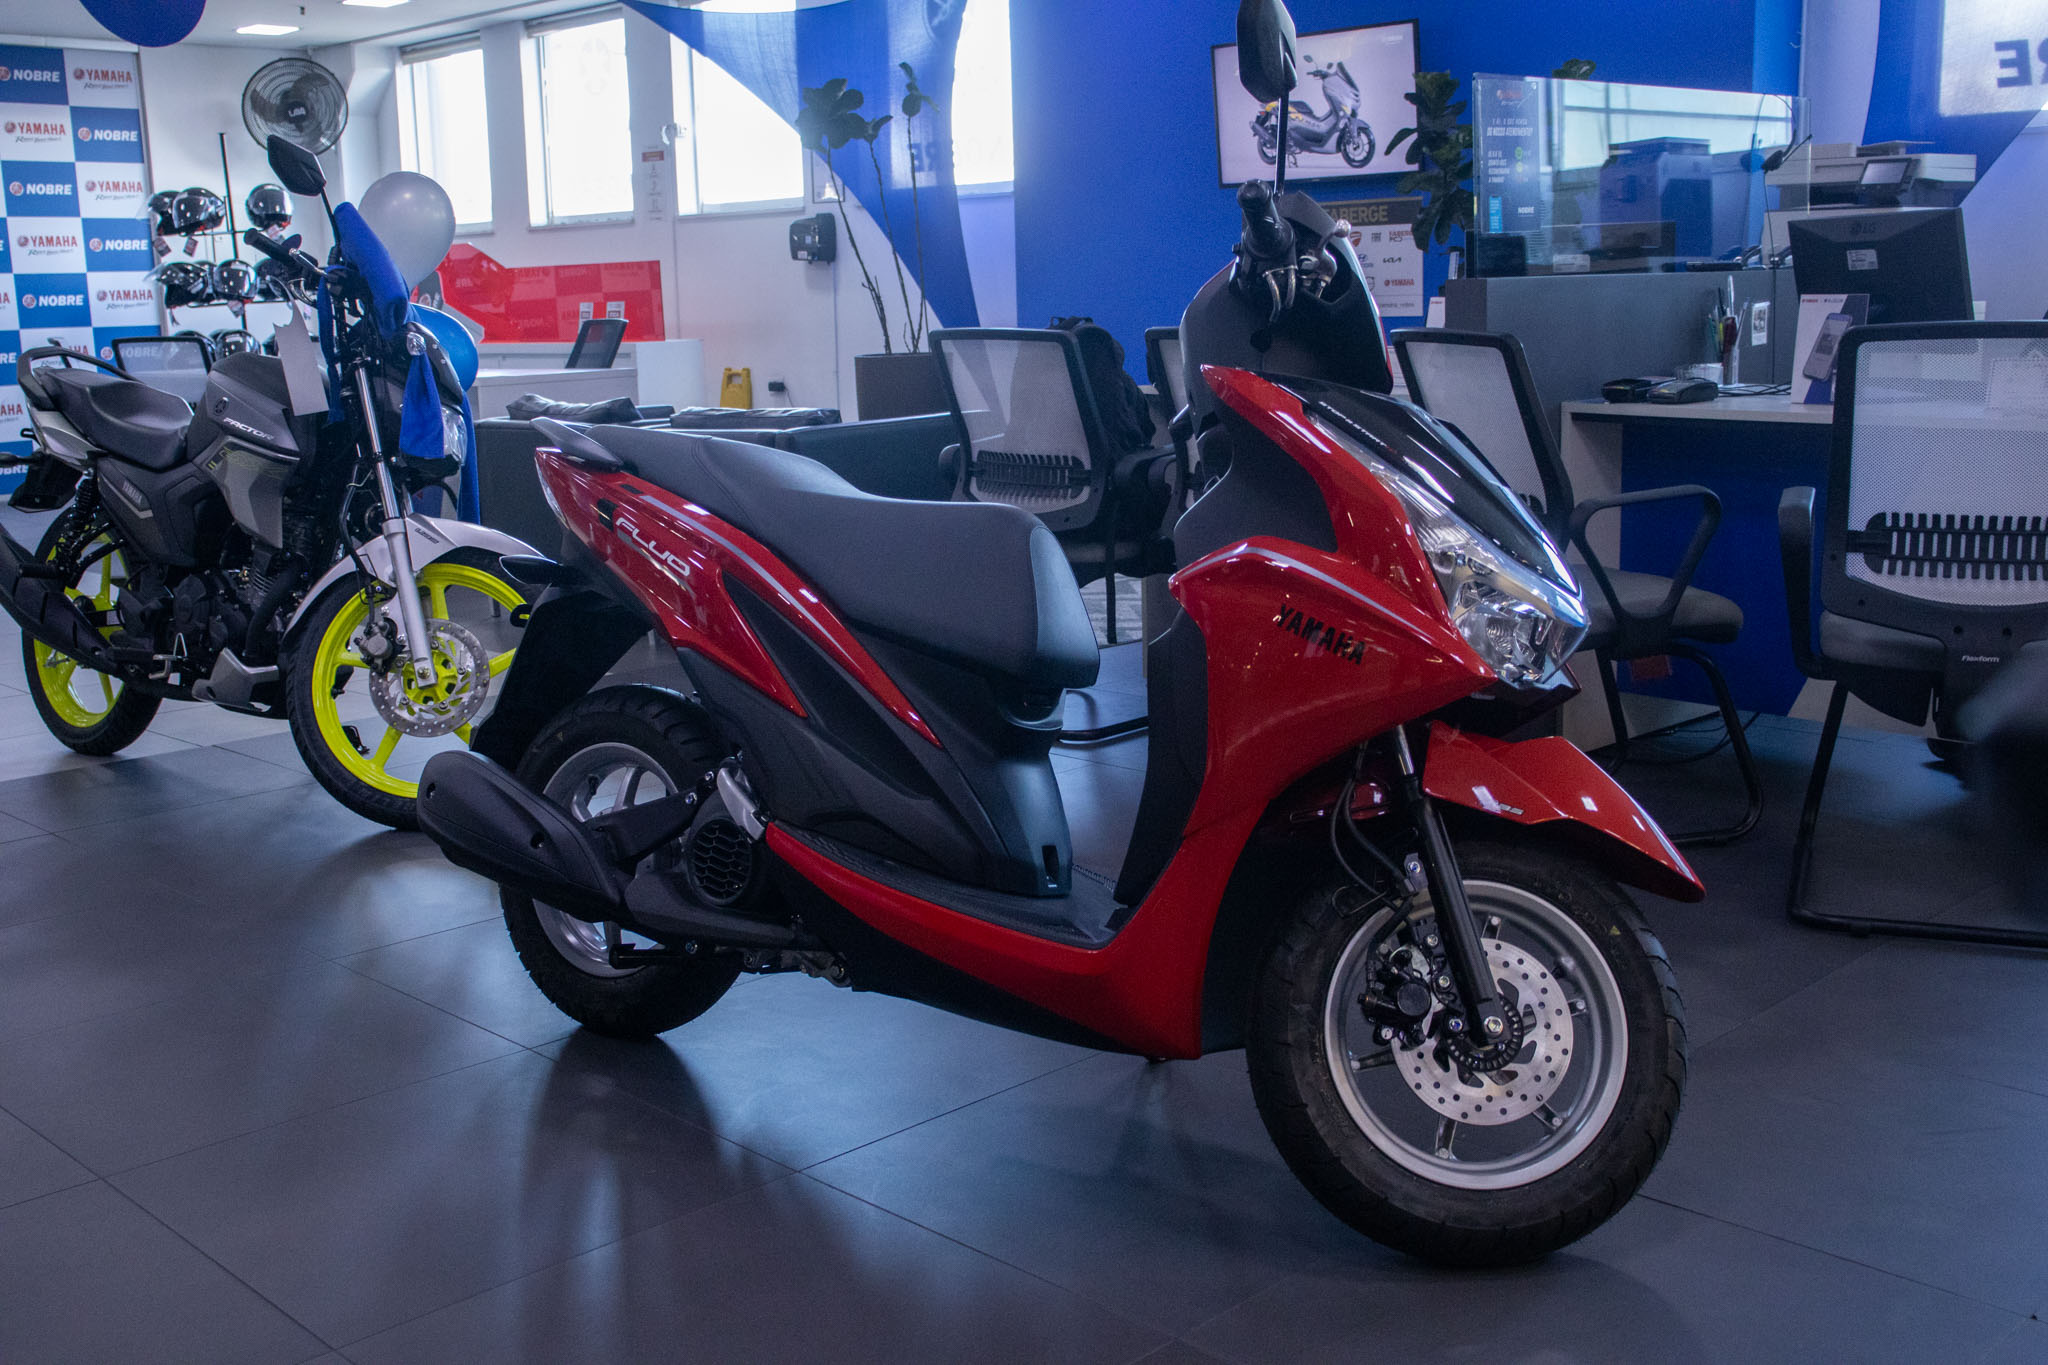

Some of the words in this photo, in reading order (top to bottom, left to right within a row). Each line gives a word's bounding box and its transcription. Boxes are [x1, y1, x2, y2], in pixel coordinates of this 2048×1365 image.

[13, 68, 61, 83] NOBRE
[87, 69, 133, 83] YAMAHA
[18, 122, 66, 136] YAMAHA
[94, 129, 138, 142] NOBRE
[26, 183, 72, 195] NOBRE
[98, 180, 144, 193] YAMAHA
[30, 235, 78, 248] YAMAHA
[105, 239, 148, 251] NOBRE
[39, 294, 84, 306] NOBRE
[108, 289, 154, 301] YAMAHA
[223, 417, 275, 441] FACTOR
[616, 517, 690, 577] FLUO
[1277, 603, 1365, 665] YAMAHA
